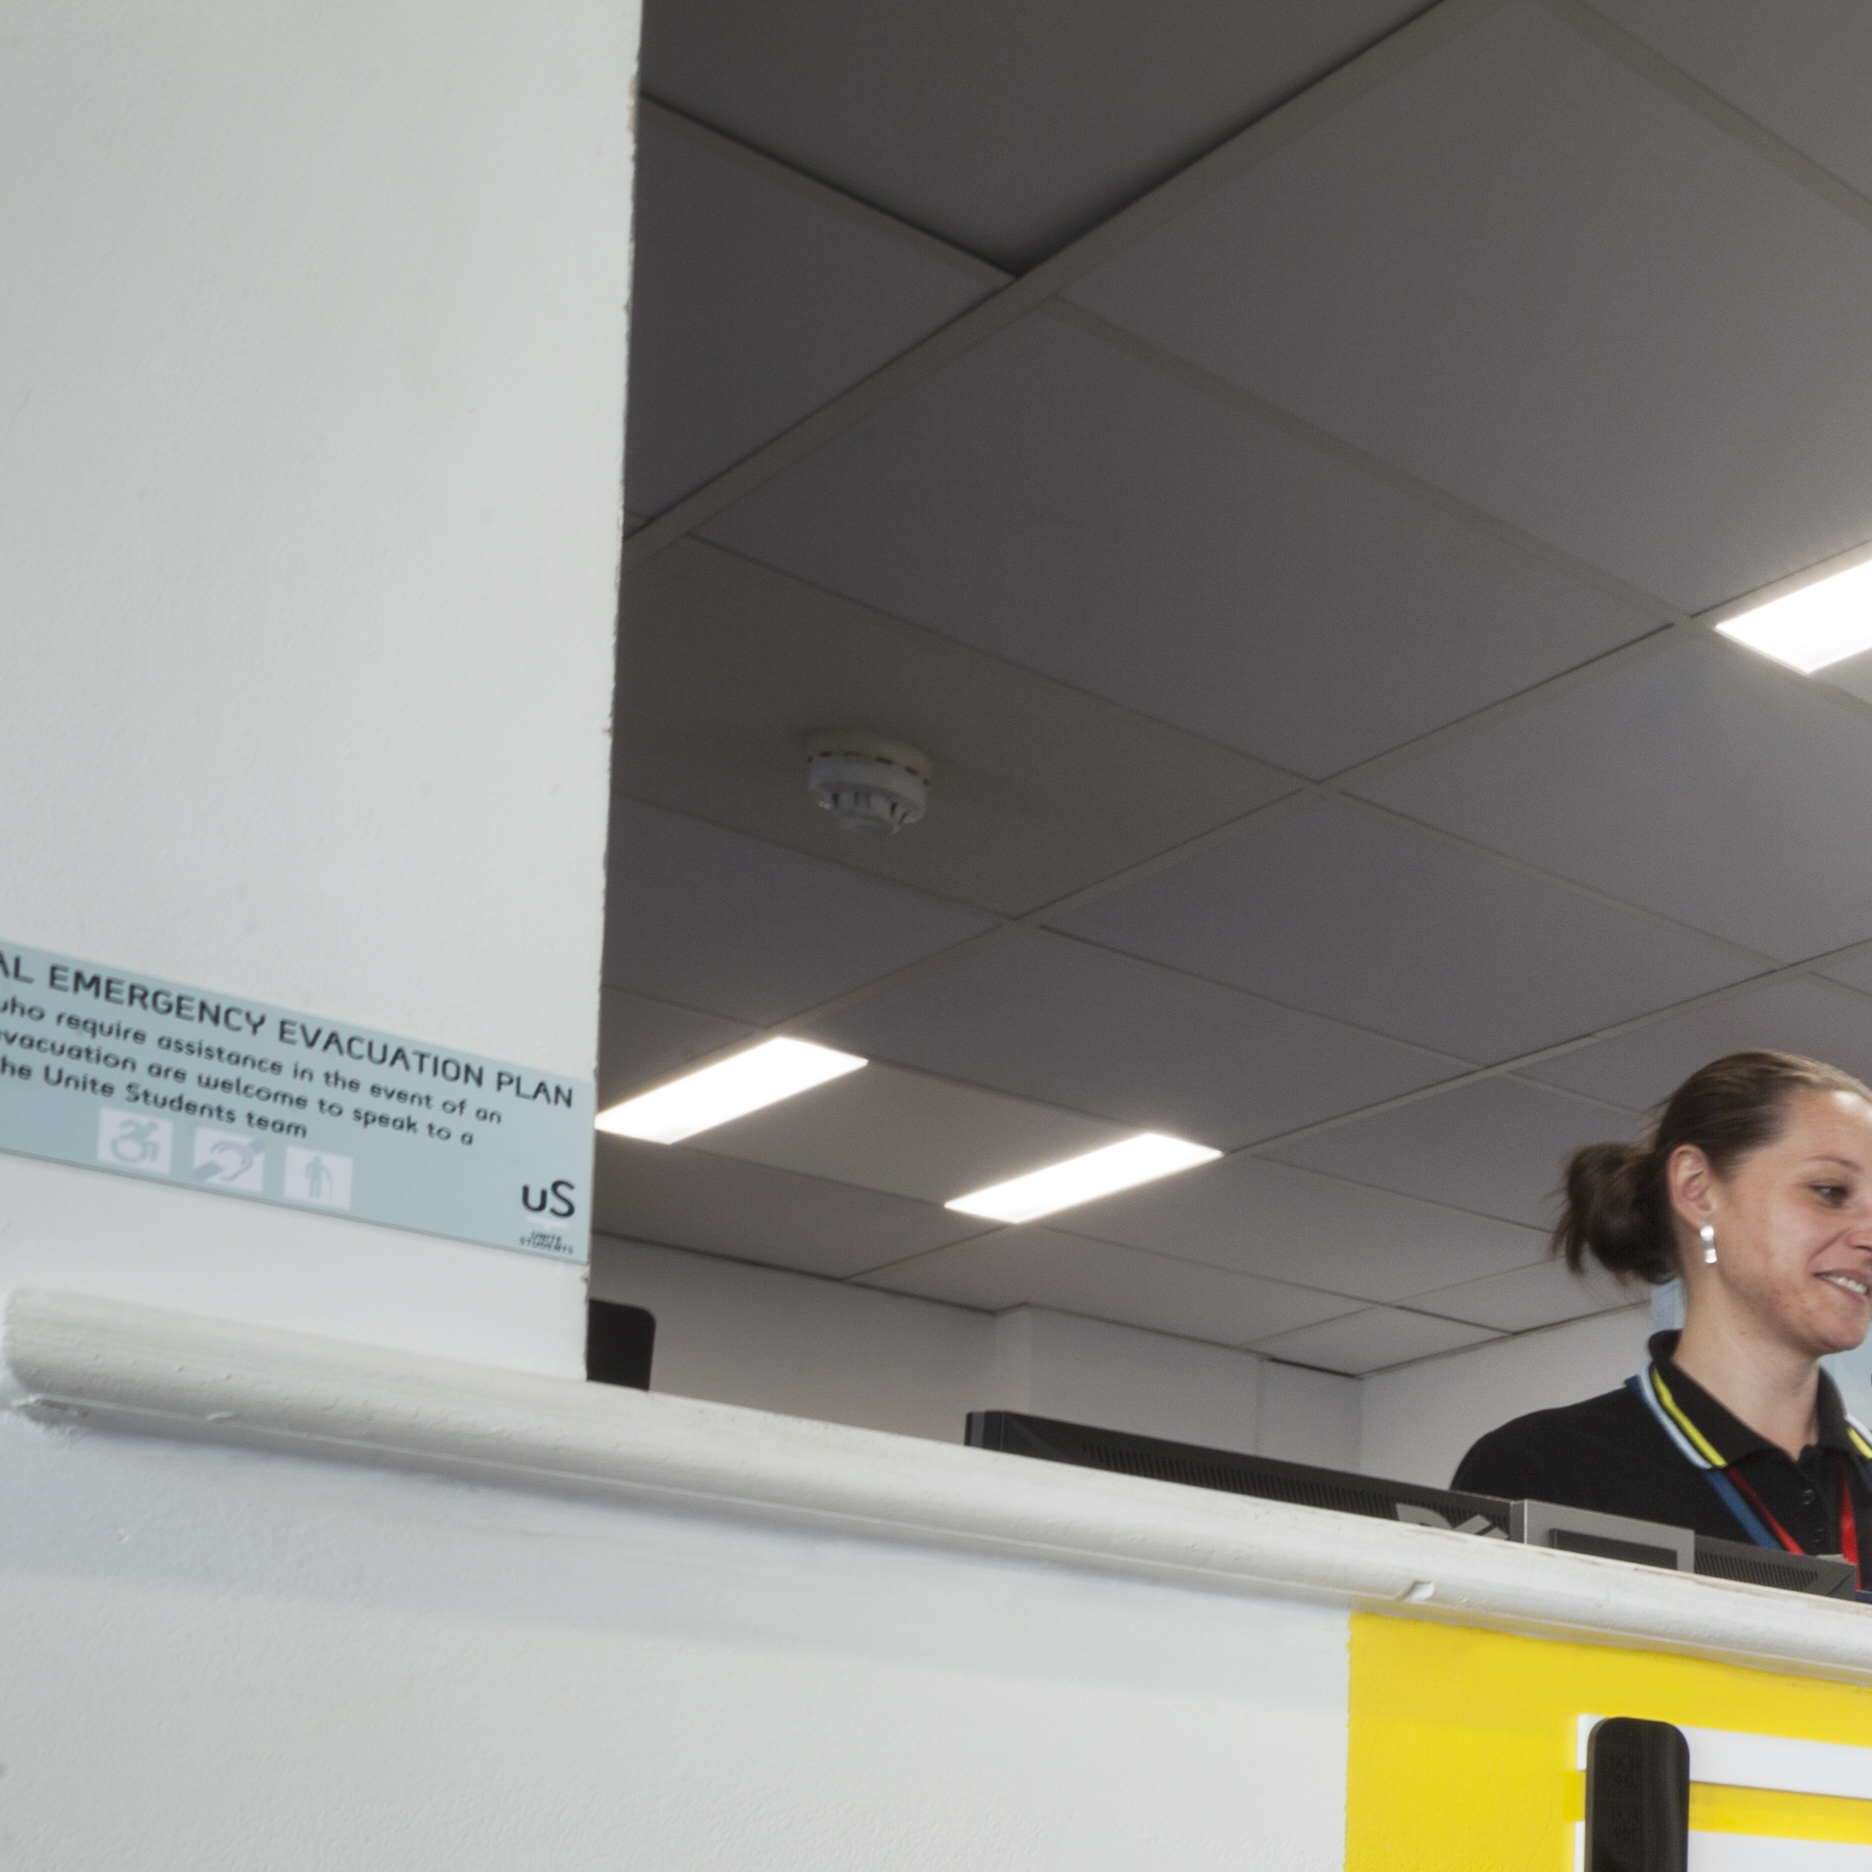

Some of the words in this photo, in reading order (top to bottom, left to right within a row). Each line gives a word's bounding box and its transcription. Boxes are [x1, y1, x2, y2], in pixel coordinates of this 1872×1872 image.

[0, 1029, 137, 1074] vacuation
[147, 1062, 188, 1084] are
[196, 1074, 308, 1111] welcome
[317, 1097, 343, 1118] to
[352, 1106, 418, 1135] speak
[427, 1120, 452, 1142] to
[460, 1131, 474, 1147] a
[49, 963, 266, 1036] EMERGENCY
[278, 1019, 484, 1088] EVACUATION
[496, 1070, 573, 1109] PLAN
[56, 1012, 147, 1045] require
[157, 1035, 283, 1075] assistance
[292, 1062, 313, 1083] in
[323, 1070, 360, 1093] the
[369, 1082, 433, 1110] event
[441, 1098, 467, 1117] of
[475, 1107, 502, 1126] an
[44, 1063, 115, 1099] Unite
[125, 1081, 237, 1125] Students
[244, 1108, 308, 1139] team
